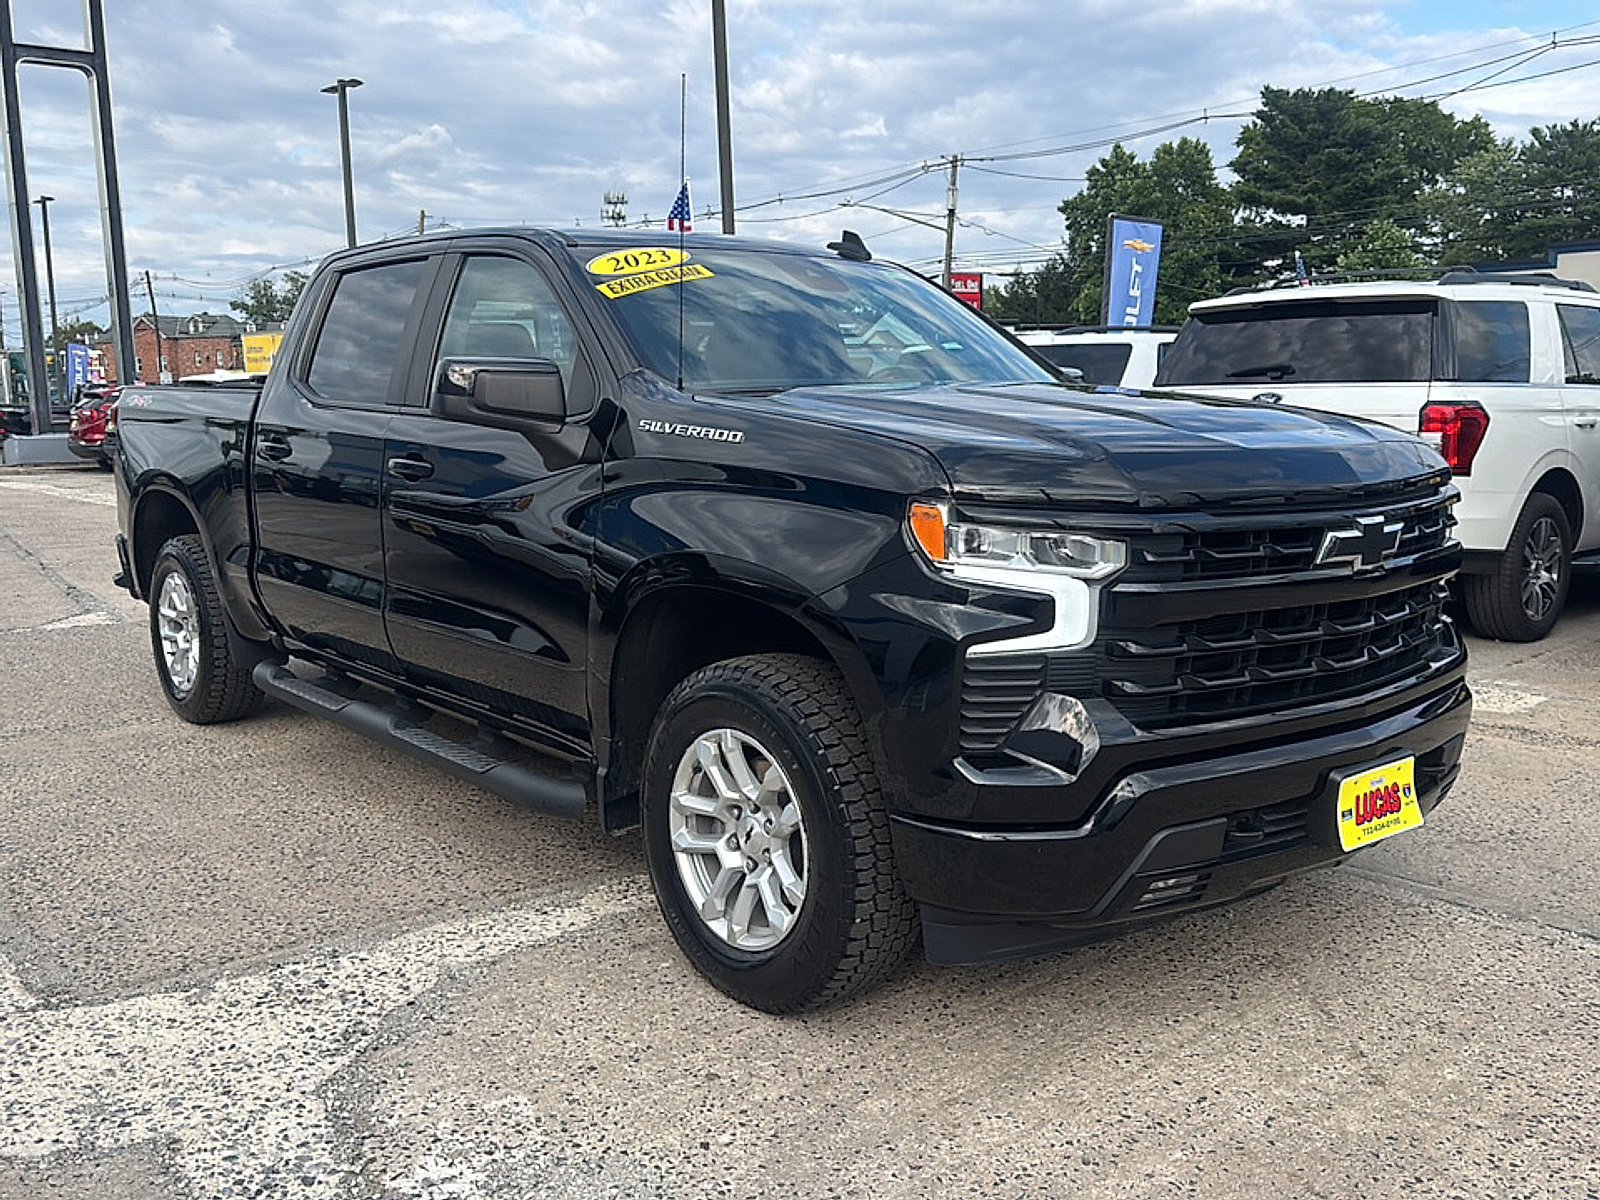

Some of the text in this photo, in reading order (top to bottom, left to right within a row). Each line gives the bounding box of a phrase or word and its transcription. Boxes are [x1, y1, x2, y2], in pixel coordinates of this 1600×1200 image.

[607, 249, 671, 272] 2023
[606, 264, 705, 294] EXTRA CLEAN
[638, 419, 745, 443] SILVERADO
[1355, 782, 1402, 827] LUCAS
